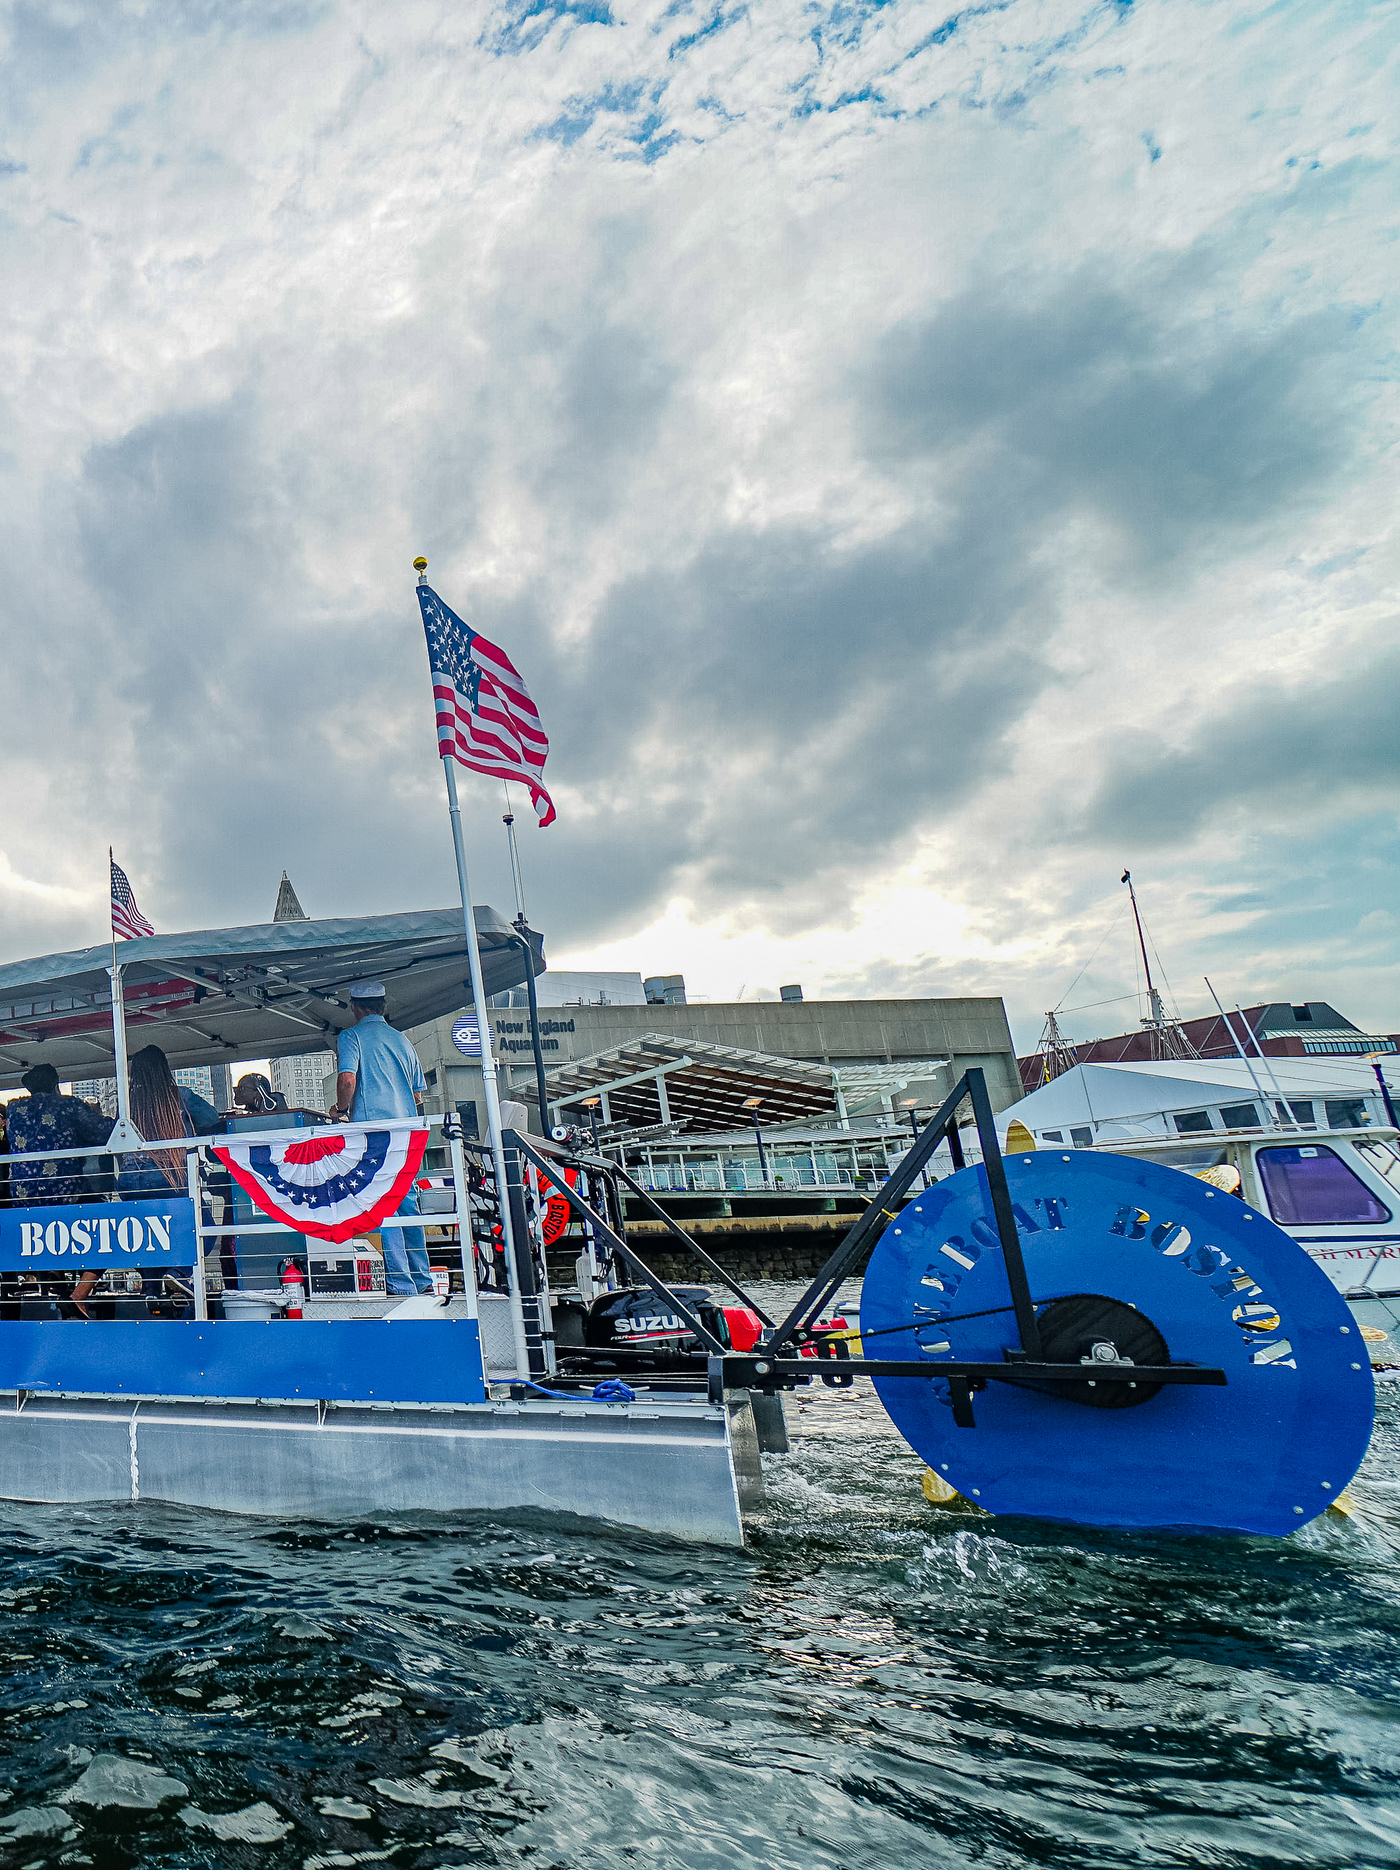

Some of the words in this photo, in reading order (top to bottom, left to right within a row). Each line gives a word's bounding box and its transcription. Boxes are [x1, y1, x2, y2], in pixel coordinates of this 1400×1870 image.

[496, 1020, 524, 1034] New
[20, 1214, 172, 1257] BOSTON
[543, 1204, 565, 1241] BOSTON
[1108, 1203, 1298, 1370] BOSTON
